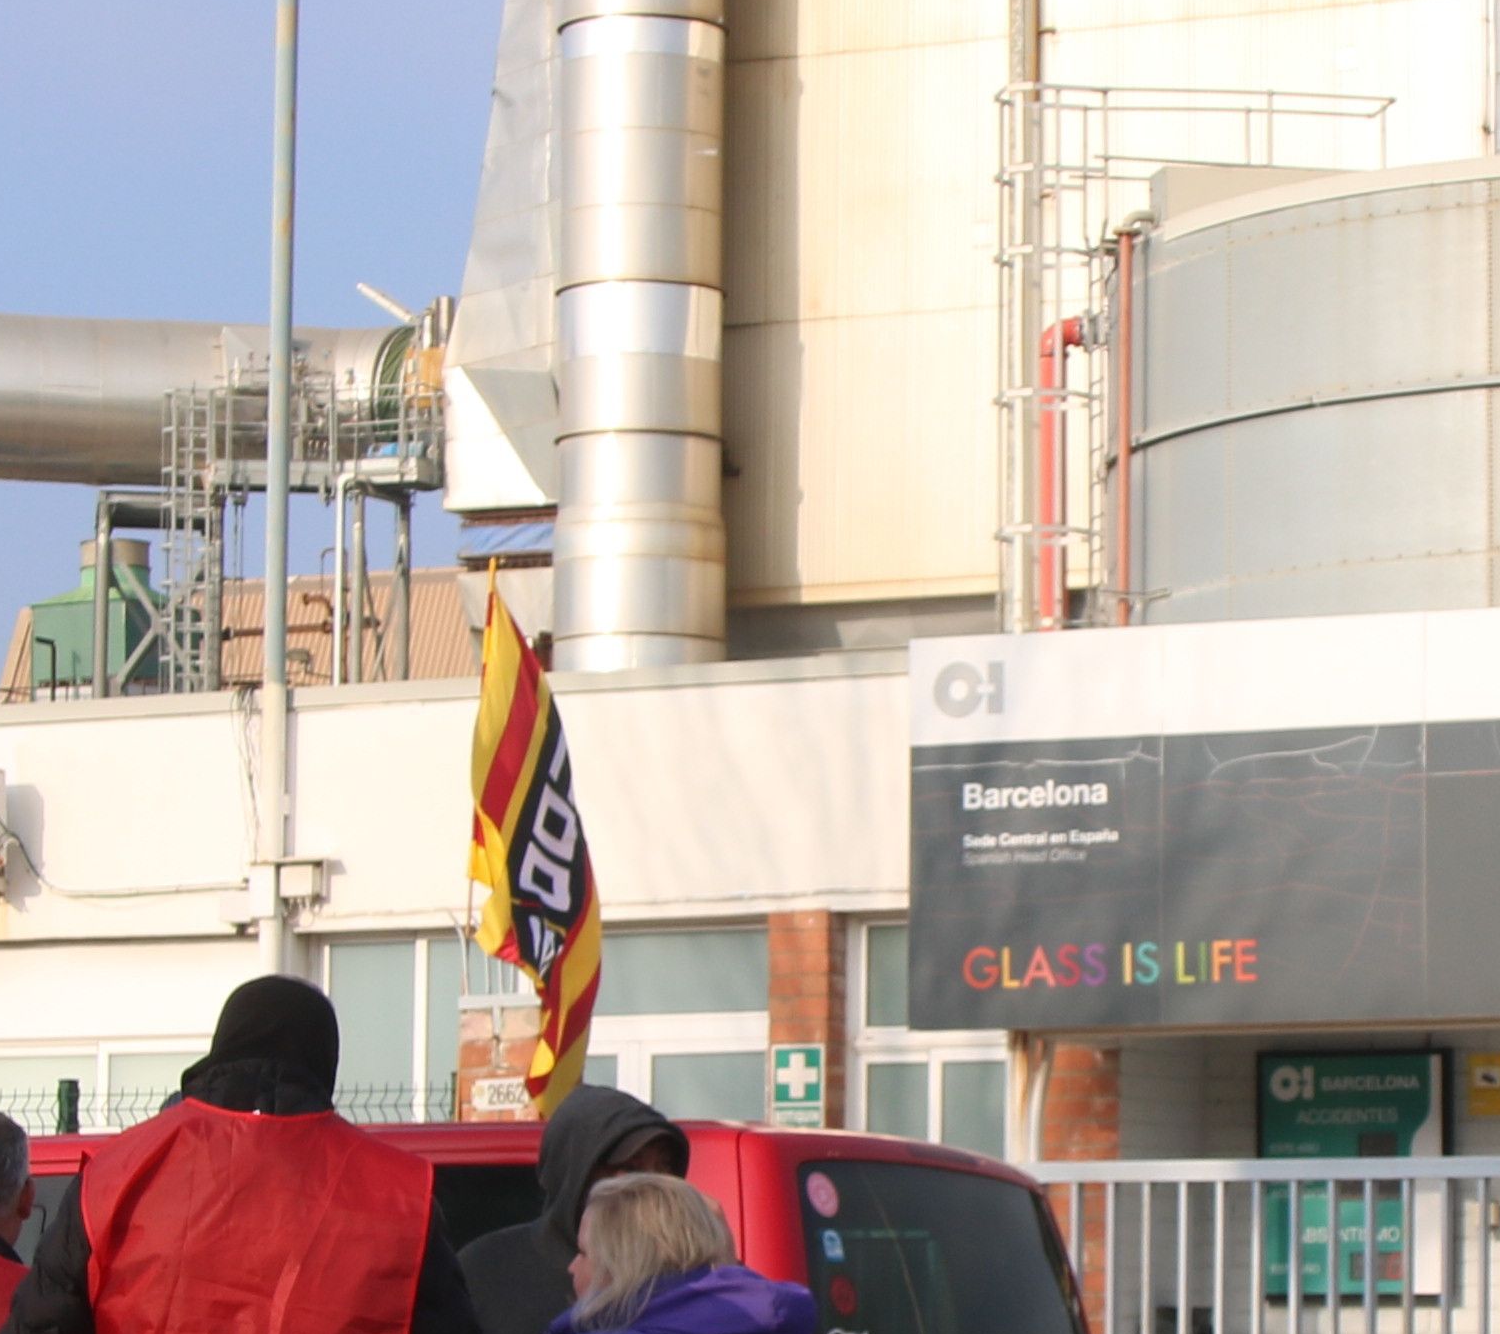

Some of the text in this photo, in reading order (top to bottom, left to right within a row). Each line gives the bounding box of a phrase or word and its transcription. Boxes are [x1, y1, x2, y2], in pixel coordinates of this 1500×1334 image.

[962, 779, 1109, 810] Barcelona
[962, 829, 1119, 848] Sede Central en España
[962, 939, 1258, 990] GLASS IS LIFE
[1321, 1075, 1419, 1091] BARCELONA
[1297, 1107, 1398, 1124] ACCIDENTES
